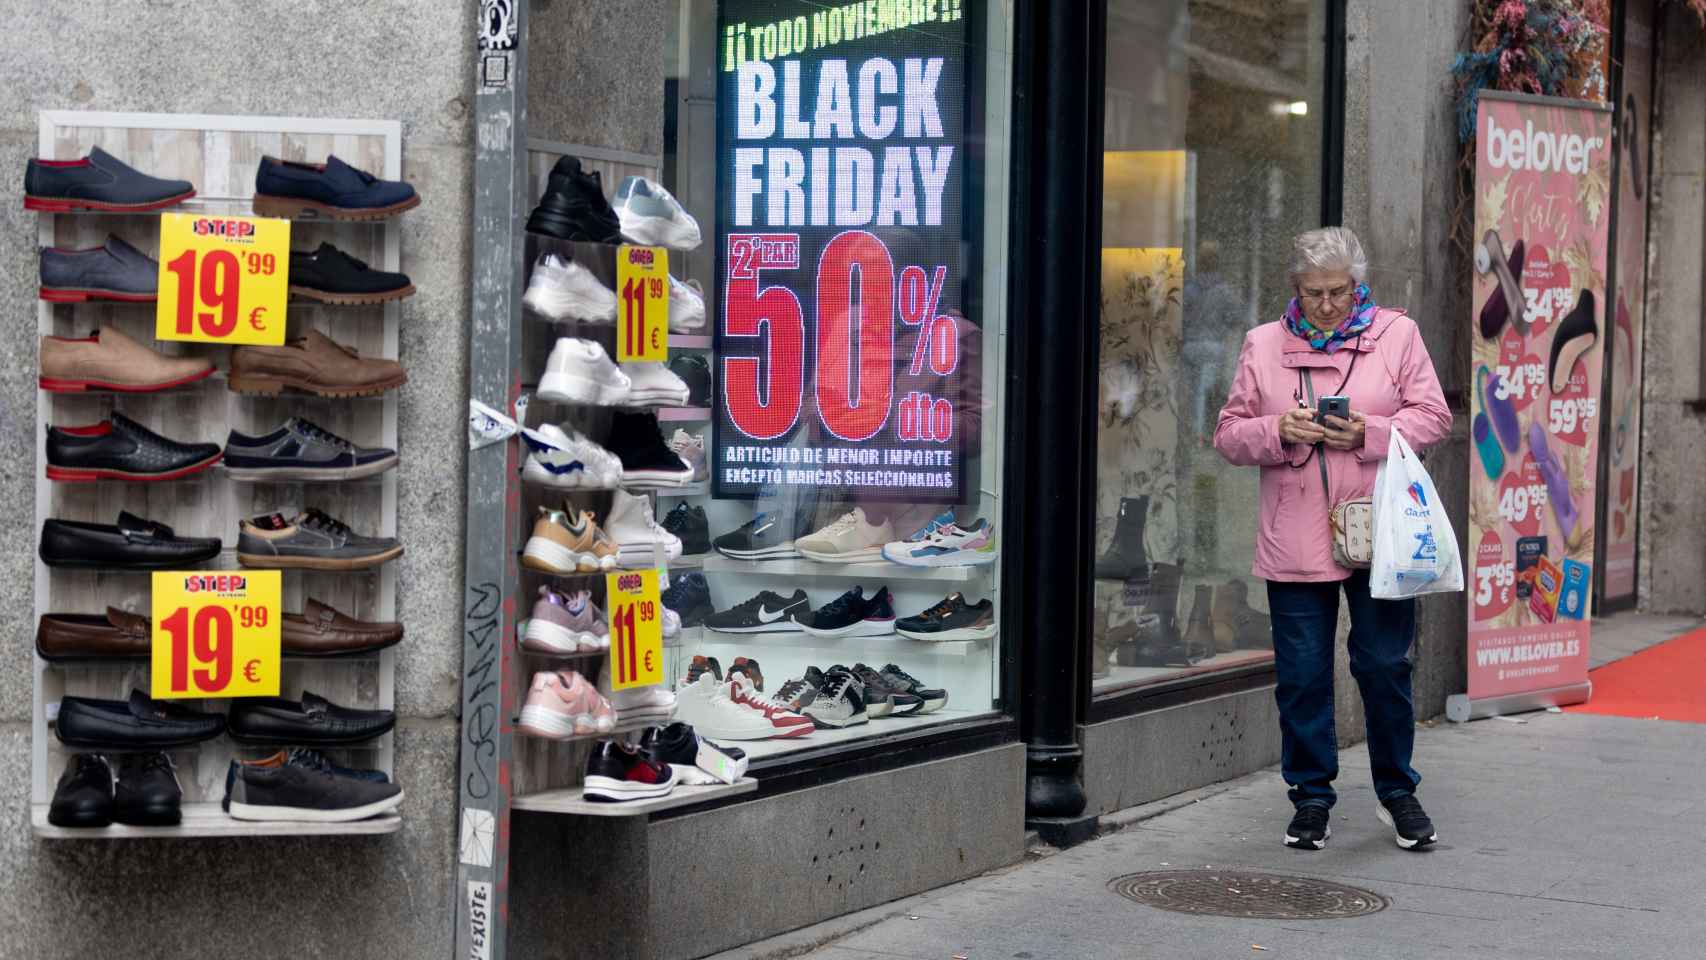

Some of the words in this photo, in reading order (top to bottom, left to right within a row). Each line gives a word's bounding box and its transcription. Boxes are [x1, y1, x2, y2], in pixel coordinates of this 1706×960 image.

[737, 57, 945, 140] BLACK
[1487, 115, 1599, 175] belover
[734, 146, 955, 226] FRIDAY
[194, 219, 254, 238] STEP
[762, 241, 797, 263] PAR
[249, 307, 268, 331] €
[651, 327, 660, 350] €
[898, 392, 953, 442] dto
[727, 446, 800, 464] ARTICULO
[803, 447, 823, 464] DE
[827, 448, 880, 466] MENOR
[884, 449, 952, 467] IMPORTE
[726, 467, 782, 484] EXCEPTO
[185, 576, 246, 592] STEP
[644, 650, 654, 673] €
[1477, 639, 1579, 668] WWW.BELOVER.ES
[243, 659, 262, 684] €
